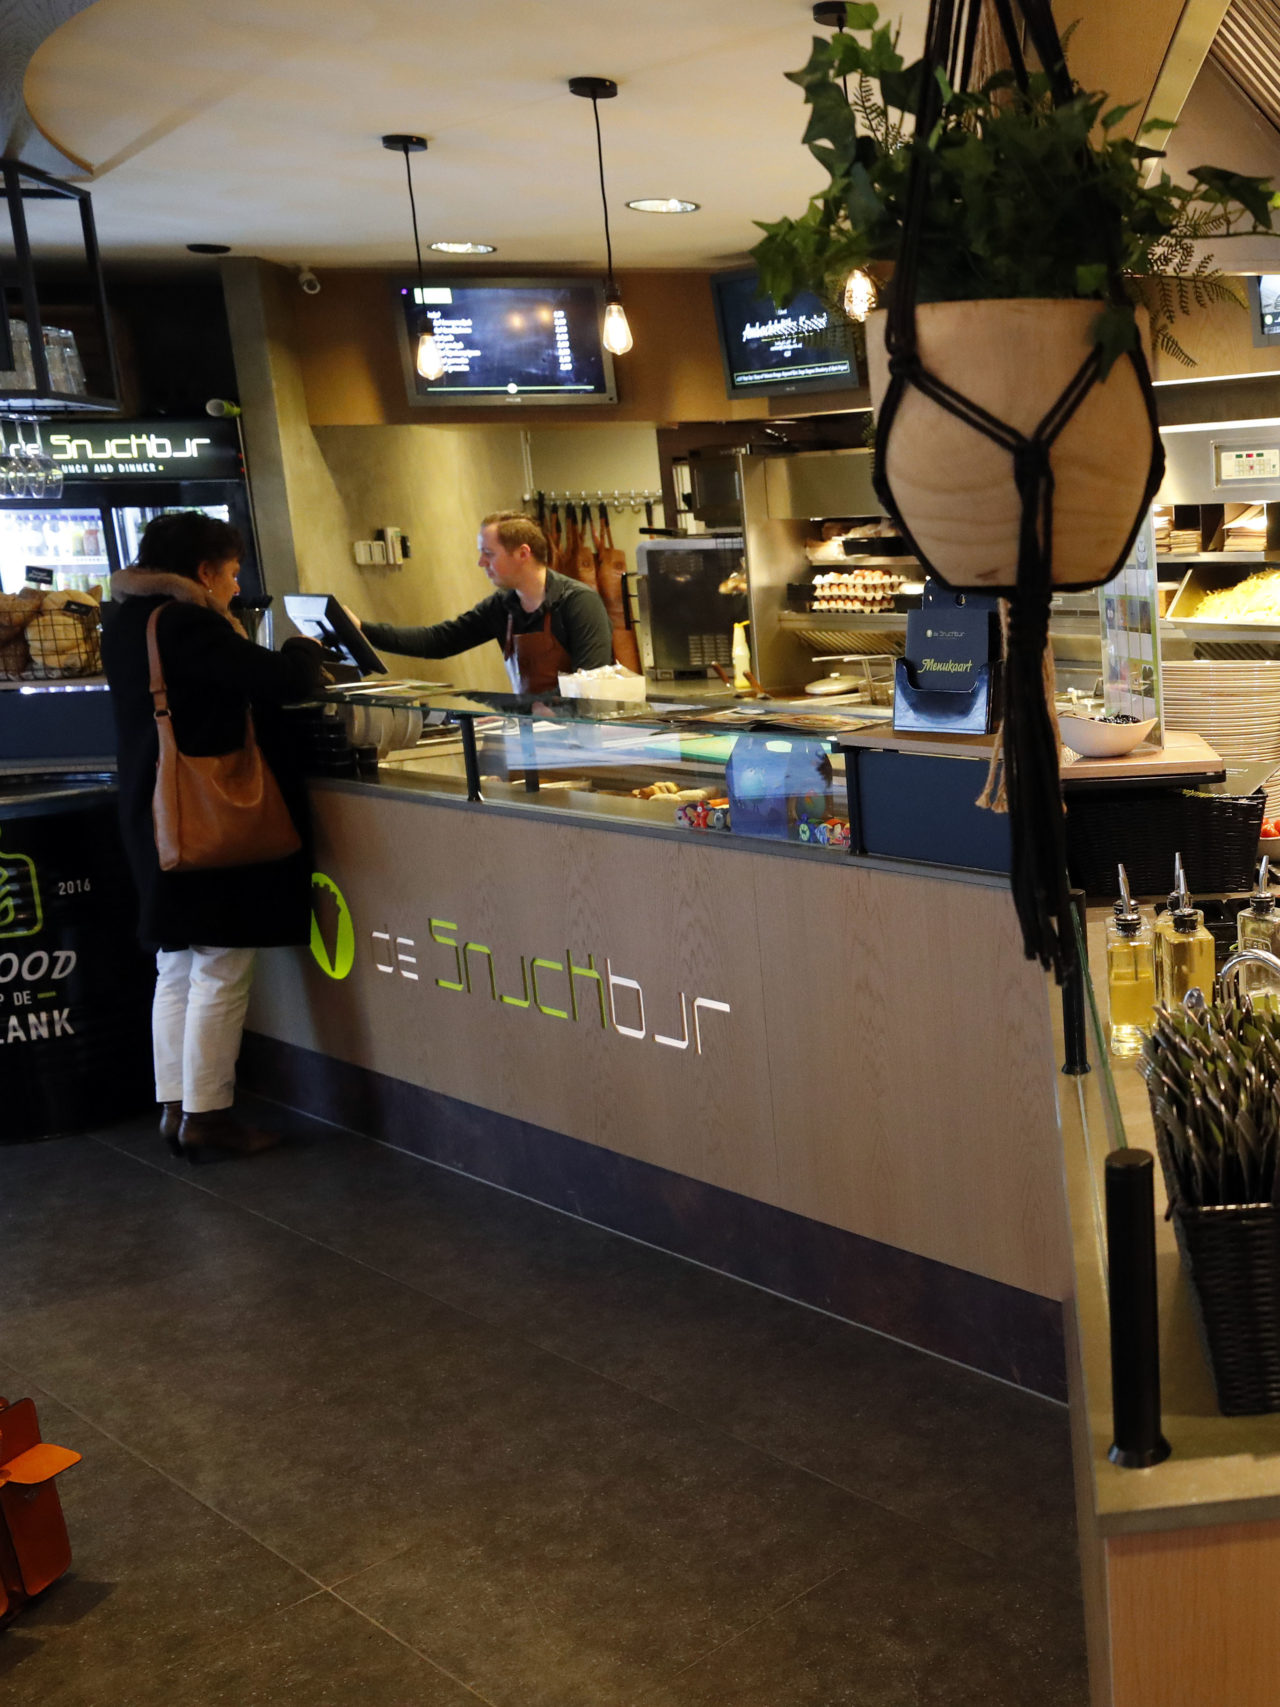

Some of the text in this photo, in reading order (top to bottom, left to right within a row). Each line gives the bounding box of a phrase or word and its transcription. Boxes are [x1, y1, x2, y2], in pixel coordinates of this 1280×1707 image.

[61, 463, 156, 474] UNCH AND DINNER
[917, 658, 972, 673] Menukaart
[58, 878, 91, 895] 2016
[13, 991, 32, 1006] DE
